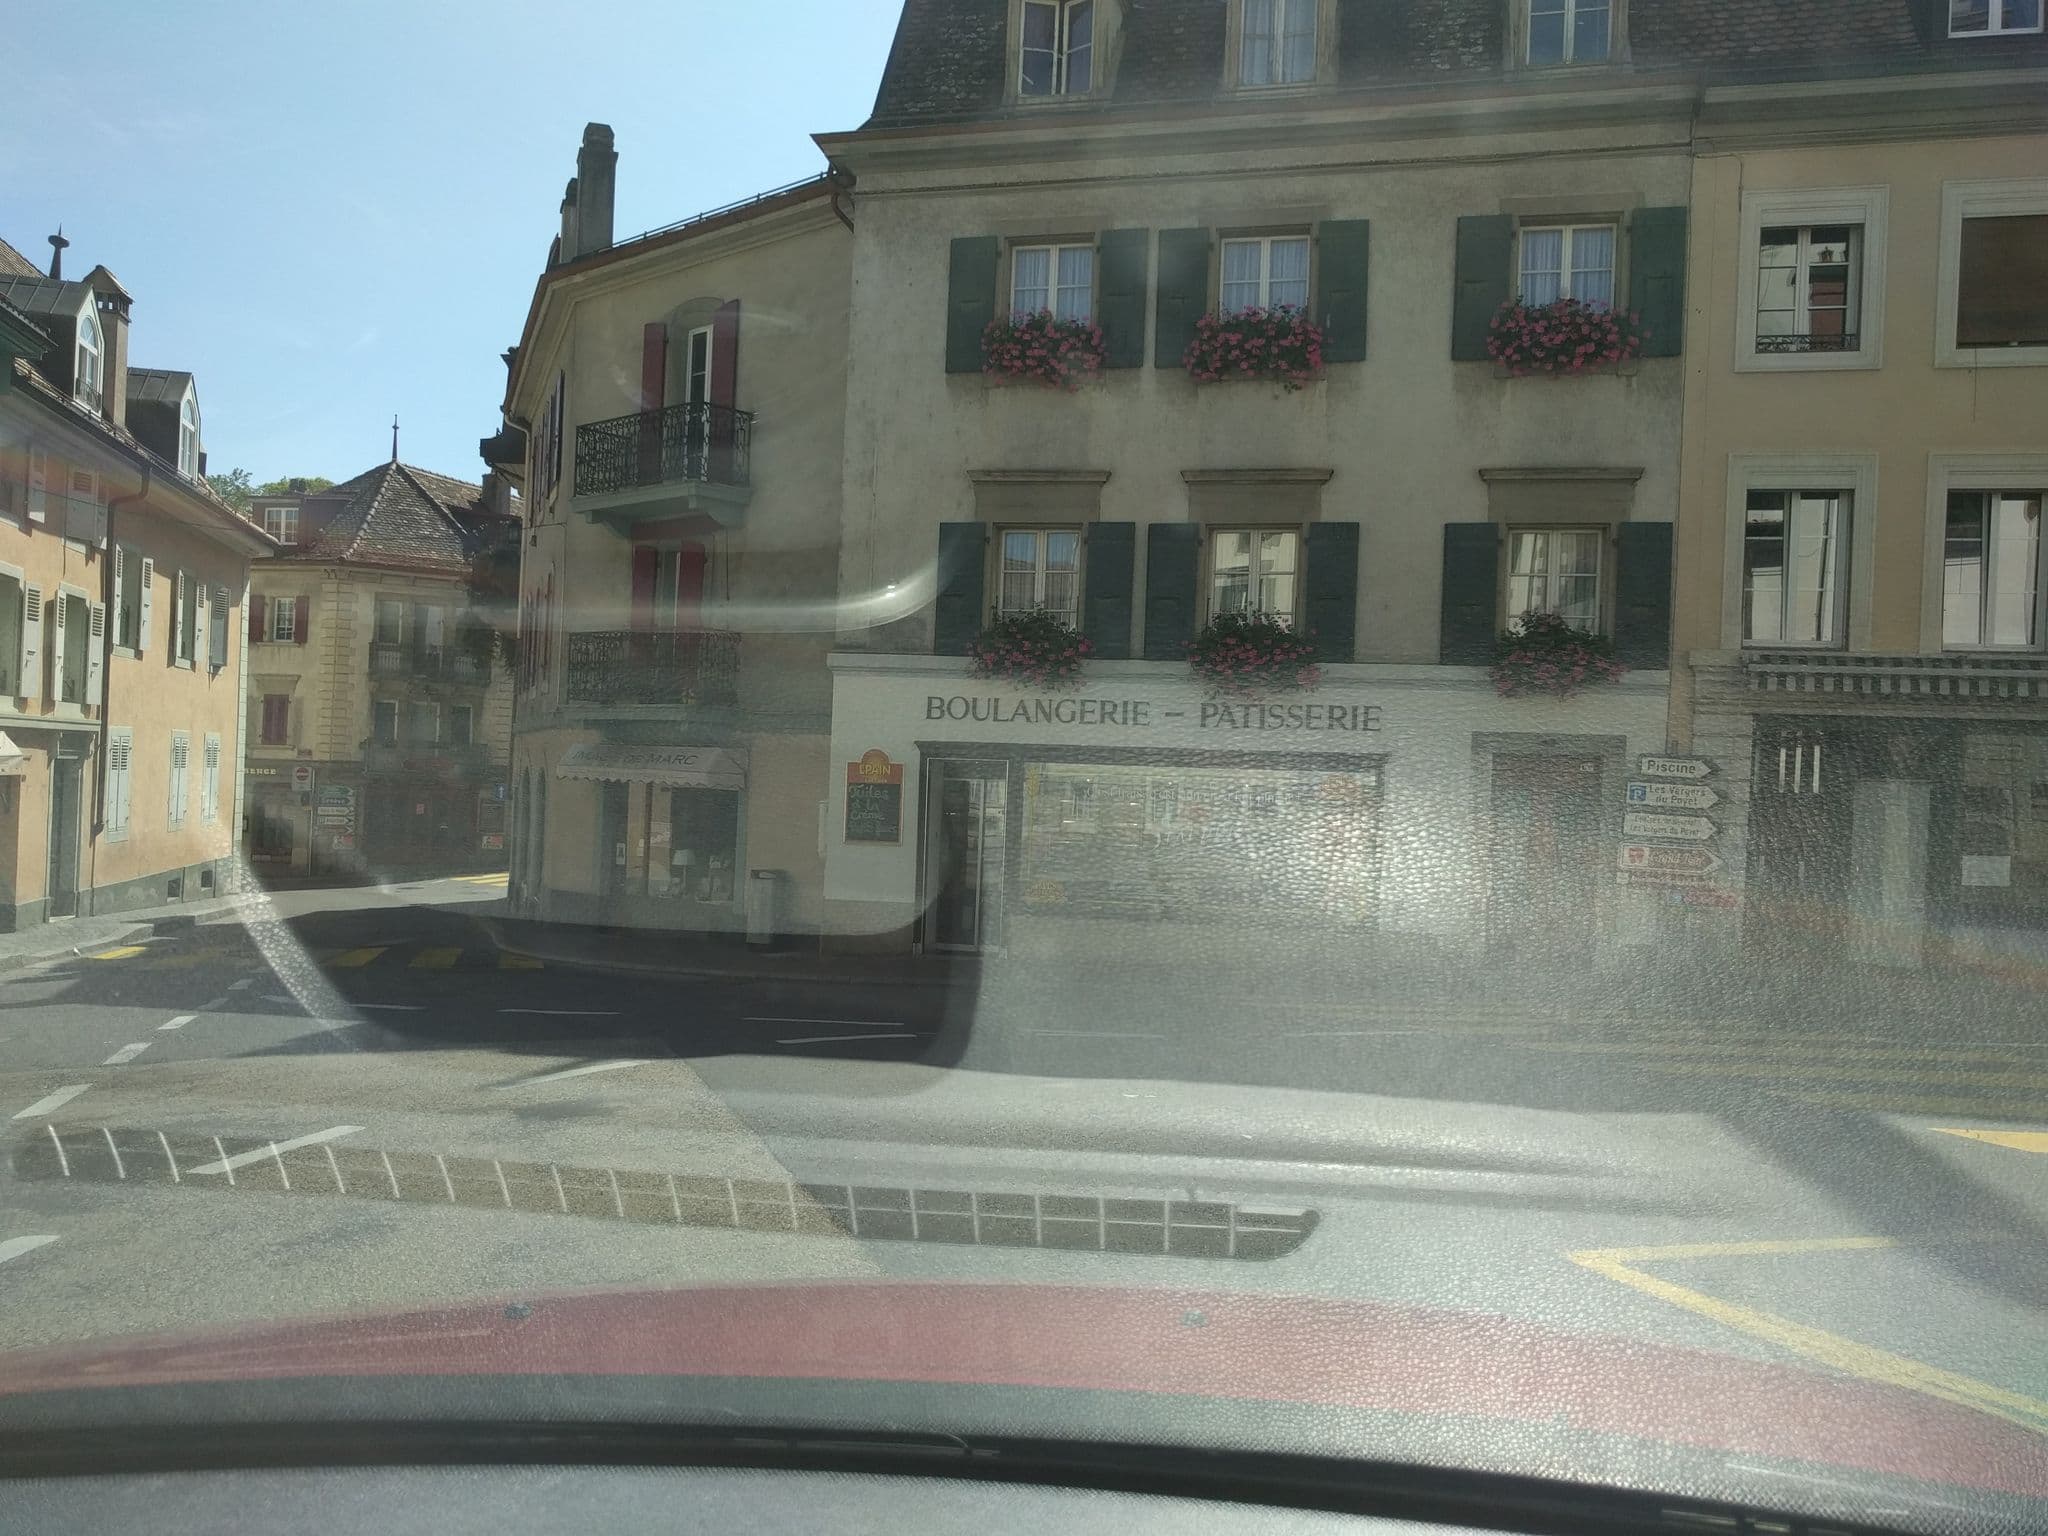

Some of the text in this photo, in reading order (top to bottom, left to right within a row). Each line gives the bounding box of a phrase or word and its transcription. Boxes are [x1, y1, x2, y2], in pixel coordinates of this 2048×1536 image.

[926, 696, 1151, 727] BOULANGERIE
[647, 752, 699, 766] MARC
[1647, 760, 1697, 775] Piscine
[1649, 785, 1706, 798] Les Vergers
[1656, 795, 1667, 804] du
